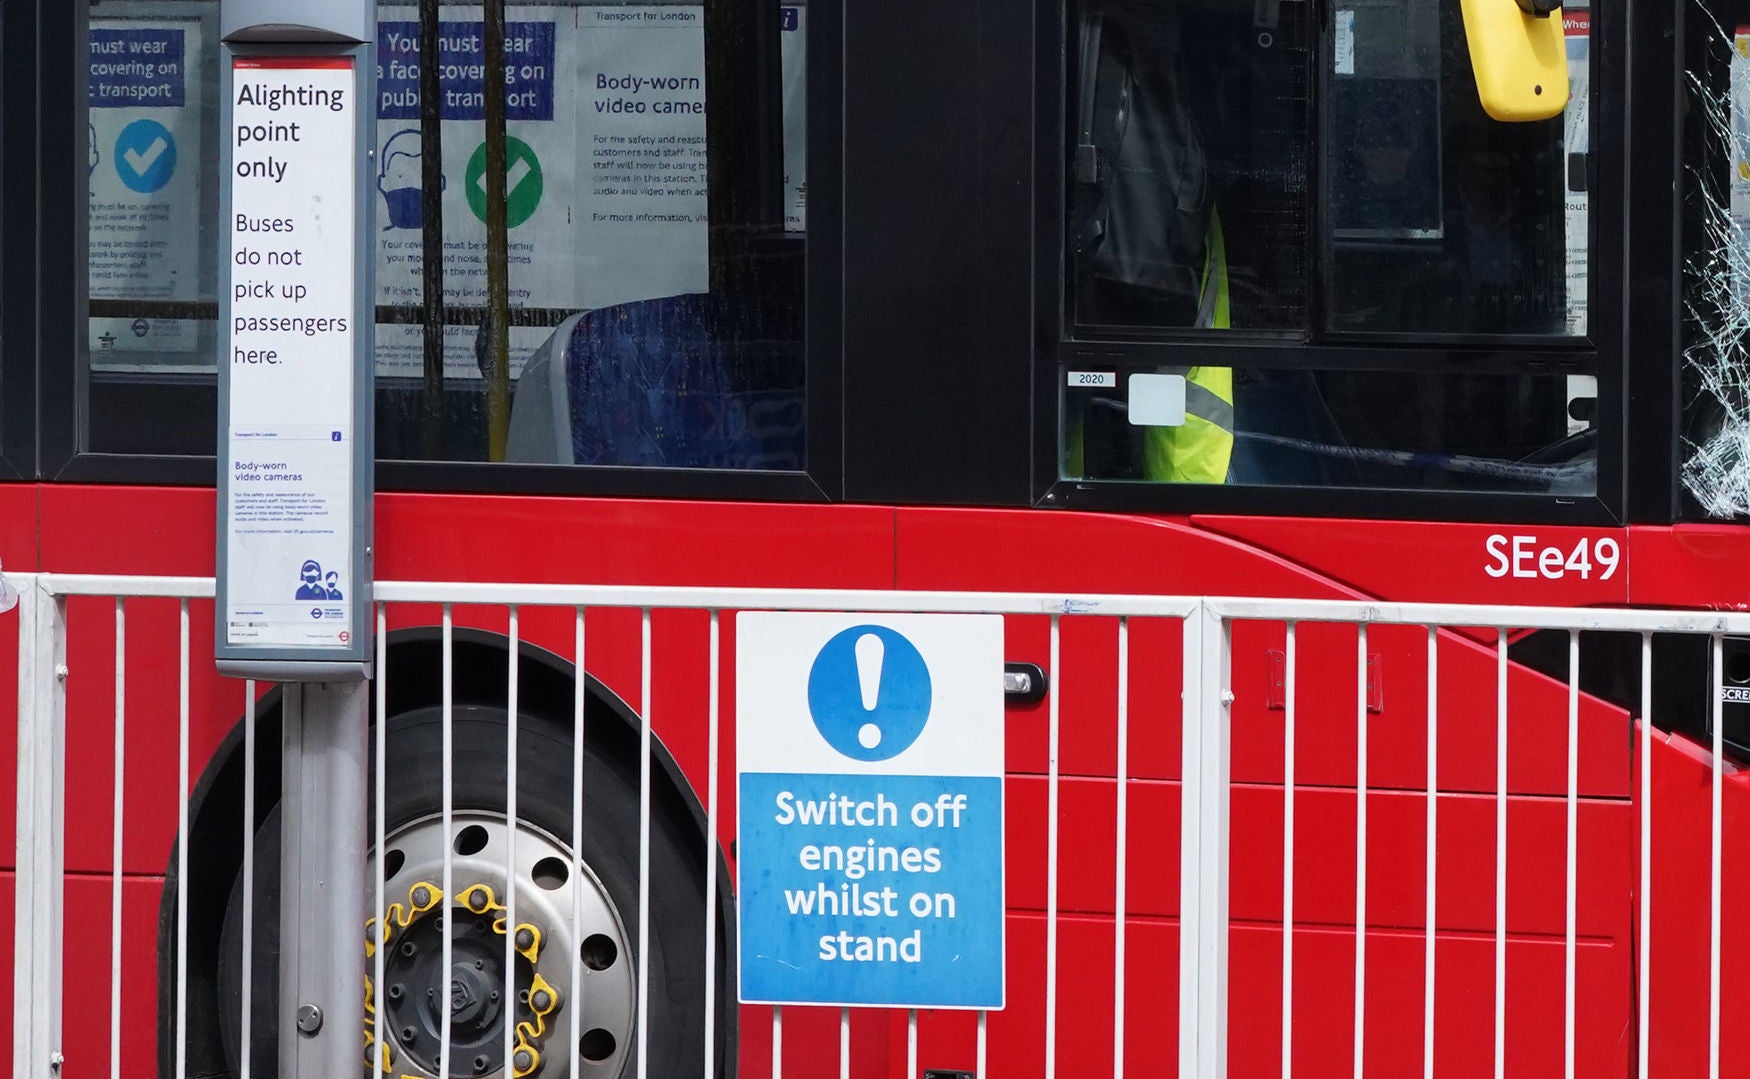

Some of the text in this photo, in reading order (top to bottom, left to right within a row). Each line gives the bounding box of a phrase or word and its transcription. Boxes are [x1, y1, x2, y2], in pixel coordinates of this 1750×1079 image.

[660, 12, 696, 21] London
[129, 41, 168, 54] wear
[504, 38, 534, 53] ear
[90, 60, 177, 79] covering on
[439, 64, 515, 84] coverg
[520, 66, 544, 80] on
[99, 82, 172, 100] transport
[596, 74, 699, 93] Body-worn
[237, 84, 344, 111] Alighting
[446, 89, 536, 107] tranort
[595, 98, 707, 114] video came
[238, 120, 300, 147] point
[628, 134, 655, 146] safety
[657, 135, 676, 144] and
[643, 148, 661, 157] and
[236, 156, 287, 183] only
[658, 160, 671, 170] be
[235, 214, 294, 233] Buses
[235, 247, 302, 266] do not
[443, 255, 455, 263] nd
[235, 281, 307, 302] pick up
[234, 314, 348, 336] passengers
[234, 346, 283, 365] here.
[1079, 374, 1104, 385] 2020
[235, 461, 287, 471] Body-worn
[235, 473, 303, 481] video cameras
[1484, 534, 1620, 580] SEe49
[775, 791, 967, 828] Switch off
[799, 838, 942, 879] engines
[784, 881, 956, 918] whilst on
[817, 930, 922, 963] stand
